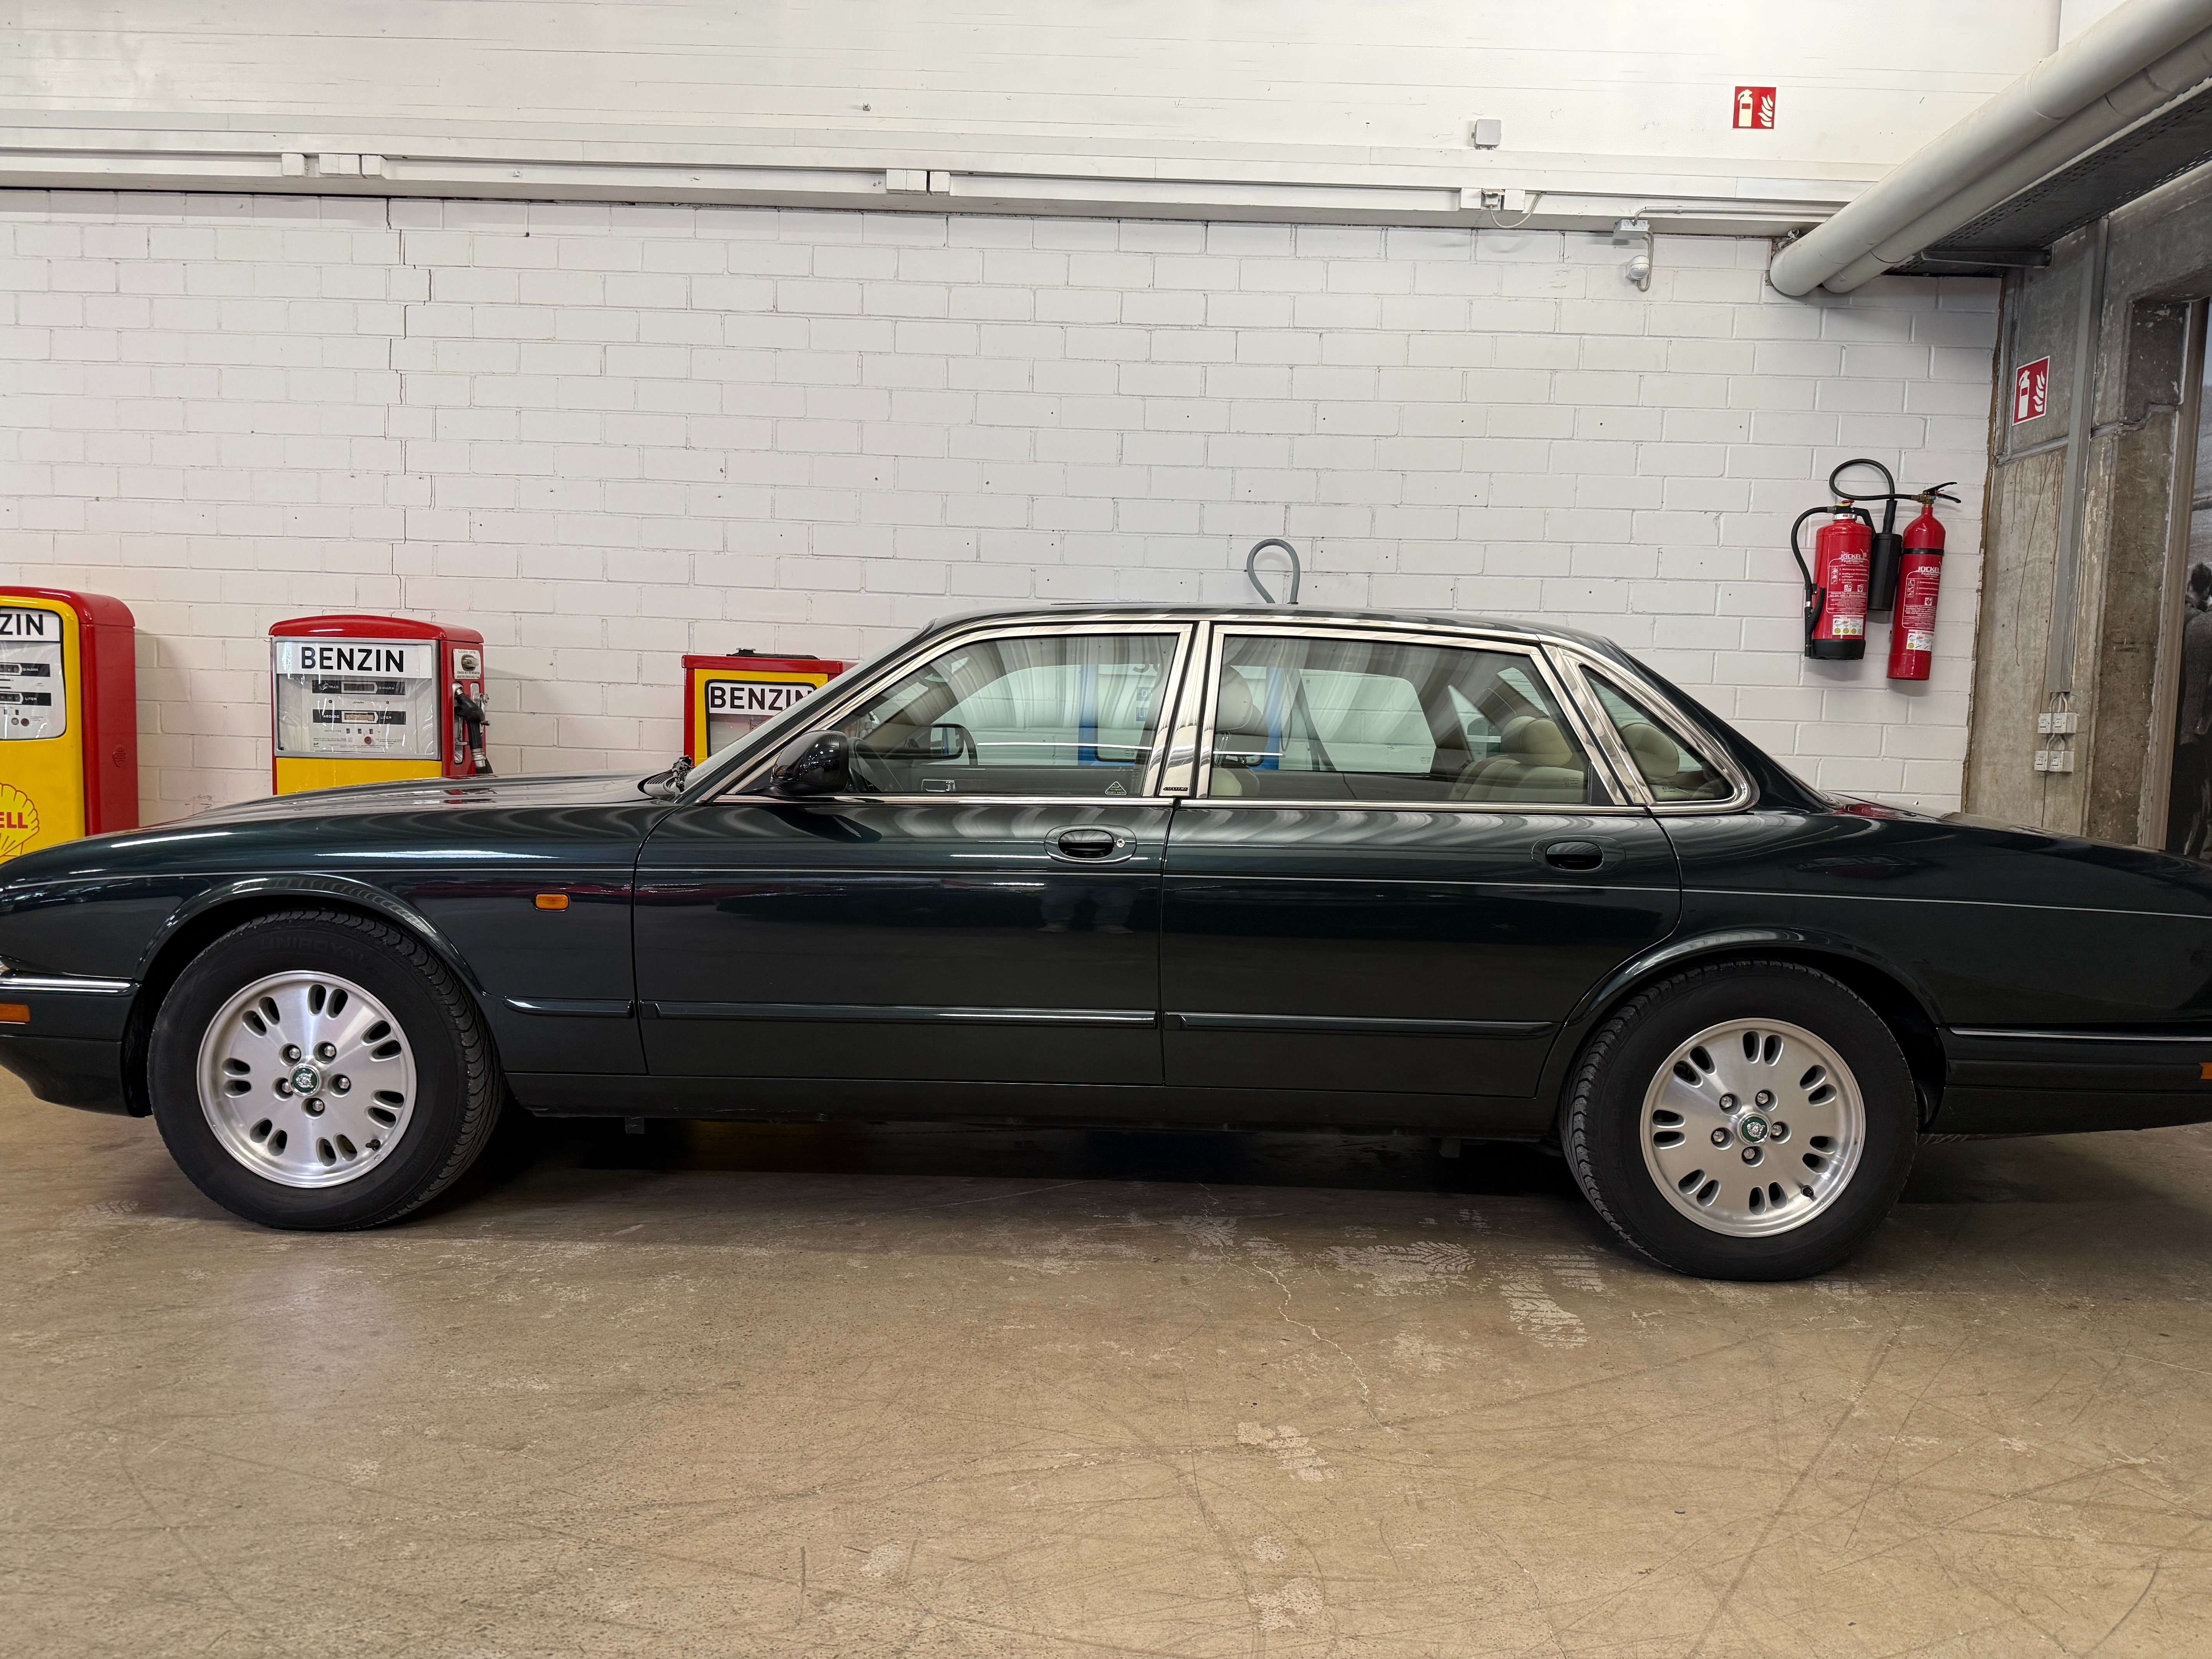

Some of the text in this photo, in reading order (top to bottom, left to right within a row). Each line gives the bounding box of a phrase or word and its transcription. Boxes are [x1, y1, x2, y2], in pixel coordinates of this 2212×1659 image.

[0, 614, 43, 635] ZIN
[302, 647, 404, 672] BENZIN
[260, 936, 365, 962] UNIROYAL
